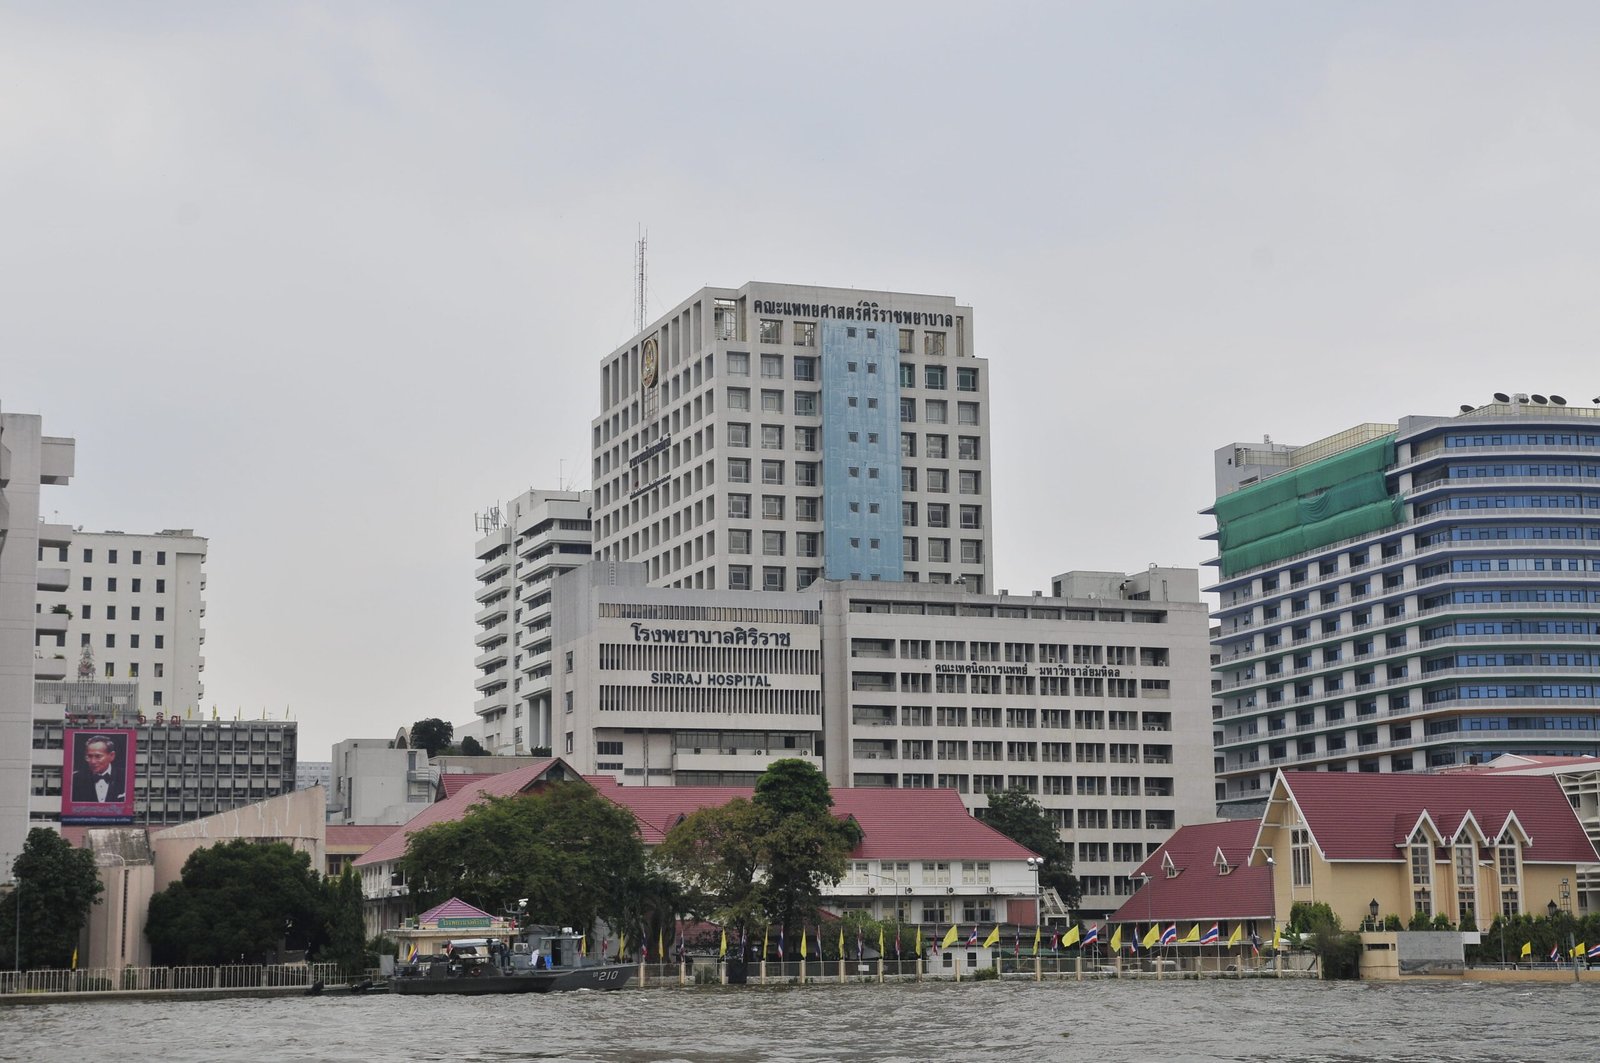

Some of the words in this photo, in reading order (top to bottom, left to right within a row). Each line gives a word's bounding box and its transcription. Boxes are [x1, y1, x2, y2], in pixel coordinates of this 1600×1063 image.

[754, 300, 953, 327] คณะแพทยศาสตร์ศิริราชพยาบาล
[631, 622, 791, 647] โรงพยาบาลศิริราช
[935, 661, 1028, 675] คณะเทคนิคการแพทย์
[651, 672, 702, 685] SIRIRAJ
[707, 674, 772, 687] HOSPITAL
[598, 970, 619, 981] 210
